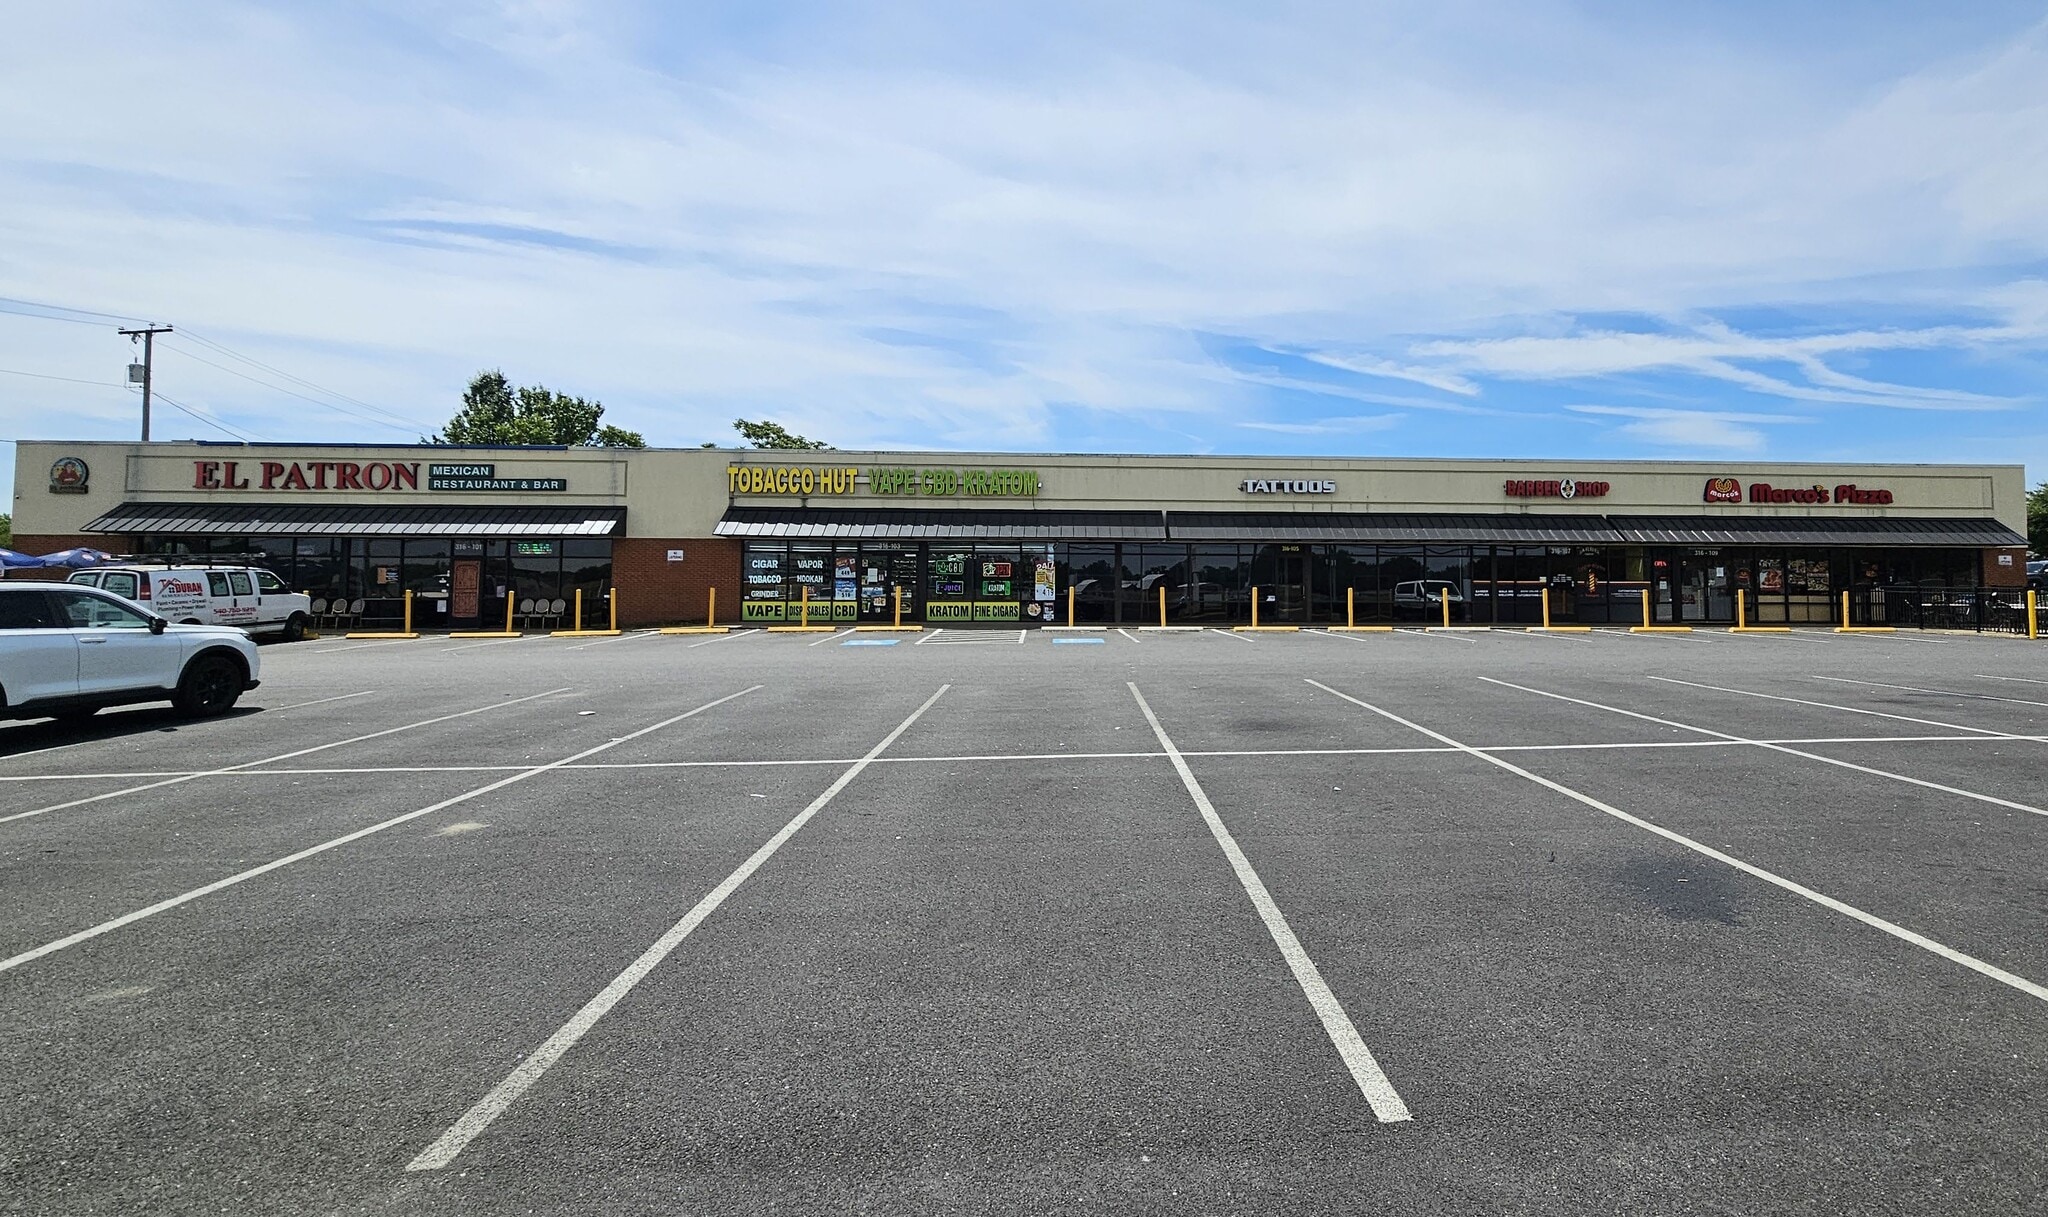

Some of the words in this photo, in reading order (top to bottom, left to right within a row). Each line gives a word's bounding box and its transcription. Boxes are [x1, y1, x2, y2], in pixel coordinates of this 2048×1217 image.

[193, 461, 249, 489] EL
[259, 462, 421, 490] PATRON
[433, 466, 489, 476] MEXICAN
[433, 480, 516, 489] RESTAURANT
[521, 480, 528, 489] &
[533, 481, 559, 489] BAR
[727, 466, 815, 494] TOBACCO
[820, 467, 858, 494] HUT
[868, 468, 915, 494] VAPE
[920, 469, 958, 495] CBD
[963, 469, 1039, 496] KRATOM
[1244, 479, 1336, 493] TATTOOS
[1506, 480, 1561, 496] BARBER
[1575, 481, 1610, 496] SHOP
[1709, 489, 1739, 498] marco's
[1750, 483, 1830, 503] Marco's
[1834, 484, 1893, 504] Pizza
[752, 560, 779, 568] CIGAR
[797, 560, 824, 568] VAPOR
[748, 575, 782, 584] TOBACCO
[175, 582, 202, 593] DURAN
[937, 583, 962, 592] E-JUICE
[988, 584, 1004, 592] KRATOM
[747, 605, 782, 616] VAPE
[789, 605, 830, 616] DISPSABLES
[834, 604, 855, 616] CBD
[930, 606, 968, 618] KRATOM
[974, 606, 990, 618] FINE
[992, 606, 1018, 618] CIGARS
